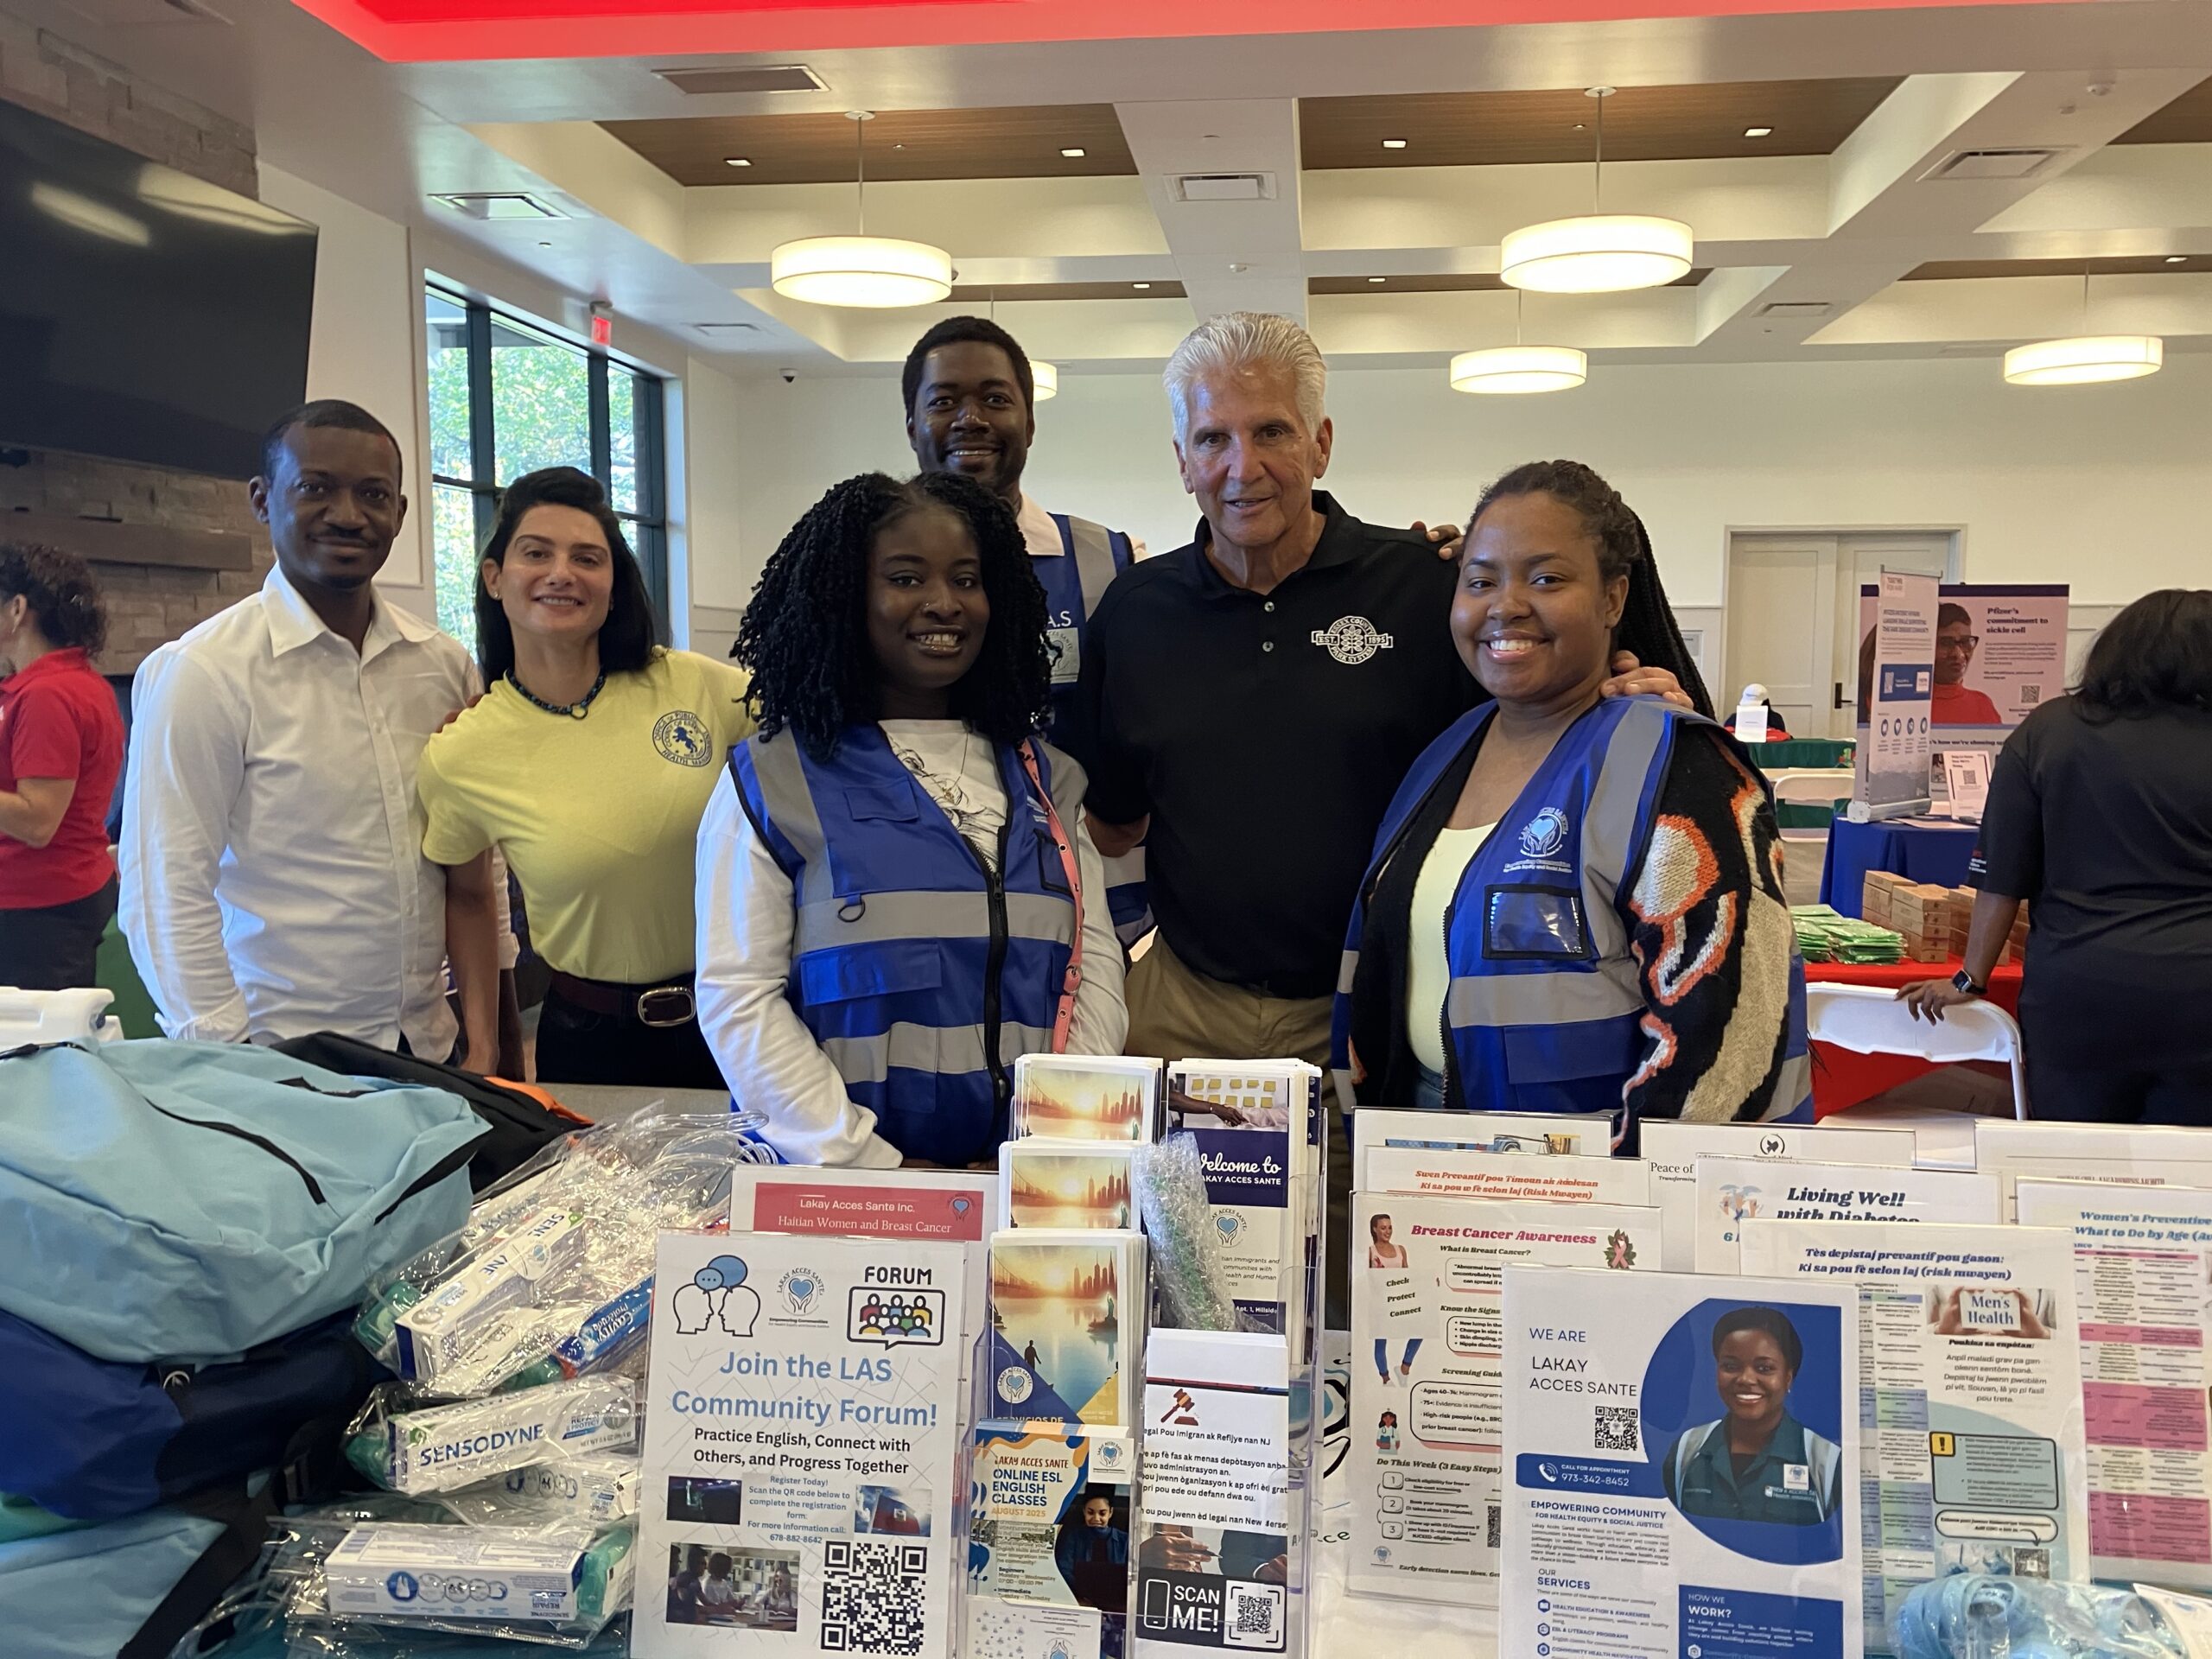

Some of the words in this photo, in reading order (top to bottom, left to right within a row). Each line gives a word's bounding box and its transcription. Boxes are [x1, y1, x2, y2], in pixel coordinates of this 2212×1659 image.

[1332, 619, 1350, 633] ESSEX
[1351, 619, 1374, 635] COUNTY
[1331, 646, 1347, 662] PARK
[1348, 646, 1374, 663] SYSTEM
[1262, 1156, 1281, 1173] to
[1650, 1162, 1680, 1173] Peace
[1682, 1164, 1694, 1173] of
[1415, 1170, 1440, 1179] Swen
[1441, 1172, 1486, 1181] Prevantif
[1505, 1175, 1541, 1184] Timoun
[1787, 1187, 1854, 1207] Living
[800, 1199, 830, 1210] Lakay
[833, 1200, 863, 1211] Acces
[866, 1201, 895, 1211] Sante
[898, 1203, 915, 1212] Inc.
[779, 1215, 814, 1227] Haitian
[817, 1217, 857, 1229] Women
[861, 1218, 878, 1230] and
[881, 1220, 912, 1232] Breast
[916, 1222, 952, 1233] Cancer
[2081, 1211, 2139, 1223] Women's
[1411, 1224, 1460, 1236] Breast
[1463, 1228, 1513, 1241] Cancer
[1516, 1230, 1597, 1244] Awareness
[2075, 1226, 2108, 1236] What
[2128, 1229, 2145, 1238] Do
[2148, 1229, 2164, 1240] by
[2166, 1230, 2190, 1241] Age
[1805, 1248, 1826, 1257] Tès
[1828, 1249, 1877, 1261] depistaj
[1878, 1250, 1936, 1262] prevantif
[1936, 1255, 1961, 1264] pou
[1961, 1255, 2005, 1264] gason:
[777, 1272, 790, 1293] LAKAY
[864, 1266, 932, 1286] FORUM
[1386, 1277, 1410, 1287] Check
[1387, 1291, 1416, 1303] Protect
[1972, 1296, 2010, 1308] Men's
[1390, 1306, 1421, 1318] Connect
[1967, 1311, 2014, 1325] Health
[1529, 1327, 1554, 1341] WE
[1557, 1329, 1586, 1344] ARE
[719, 1351, 779, 1378] Join
[786, 1354, 832, 1379] the
[839, 1357, 893, 1382] LAS
[1532, 1356, 1588, 1373] LAKAY
[1529, 1377, 1583, 1394] ACCES
[1587, 1381, 1637, 1397] SANTE
[671, 1391, 832, 1427] Community
[839, 1399, 938, 1427] Forum!
[694, 1427, 753, 1446] Practice
[755, 1432, 811, 1450] English,
[815, 1434, 876, 1452] Connect
[879, 1437, 911, 1452] with
[1160, 1428, 1175, 1437] Pou
[420, 1424, 544, 1467] SENSODYNE
[693, 1449, 747, 1468] Others,
[749, 1452, 776, 1467] and
[779, 1455, 842, 1472] Progress
[844, 1457, 909, 1475] Together
[1020, 1458, 1043, 1467] ACCES
[1045, 1459, 1069, 1469] SANTE
[1472, 1465, 1502, 1474] Steps)
[770, 1476, 801, 1484] Register
[803, 1478, 828, 1487] Today!
[993, 1469, 1039, 1482] ONLINE
[1042, 1471, 1063, 1483] ESL
[1561, 1473, 1630, 1486] 973-342-8452
[993, 1480, 1046, 1495] ENGLISH
[749, 1498, 785, 1507] complete
[802, 1502, 847, 1510] registration
[991, 1493, 1047, 1507] CLASSES
[991, 1508, 1024, 1516] AUGUST
[1531, 1500, 1599, 1513] EMPOWERING
[1602, 1506, 1666, 1519] COMMUNITY
[1173, 1510, 1196, 1519] jwenn
[1209, 1514, 1227, 1522] legal
[1245, 1517, 1262, 1526] New
[770, 1534, 822, 1544] 678-882-8642
[1537, 1577, 1590, 1589] SERVICES
[1173, 1585, 1221, 1605] SCAN
[1688, 1594, 1709, 1603] HOW
[1712, 1595, 1726, 1604] WE
[1172, 1604, 1219, 1633] ME!
[1688, 1605, 1732, 1618] WORK?
